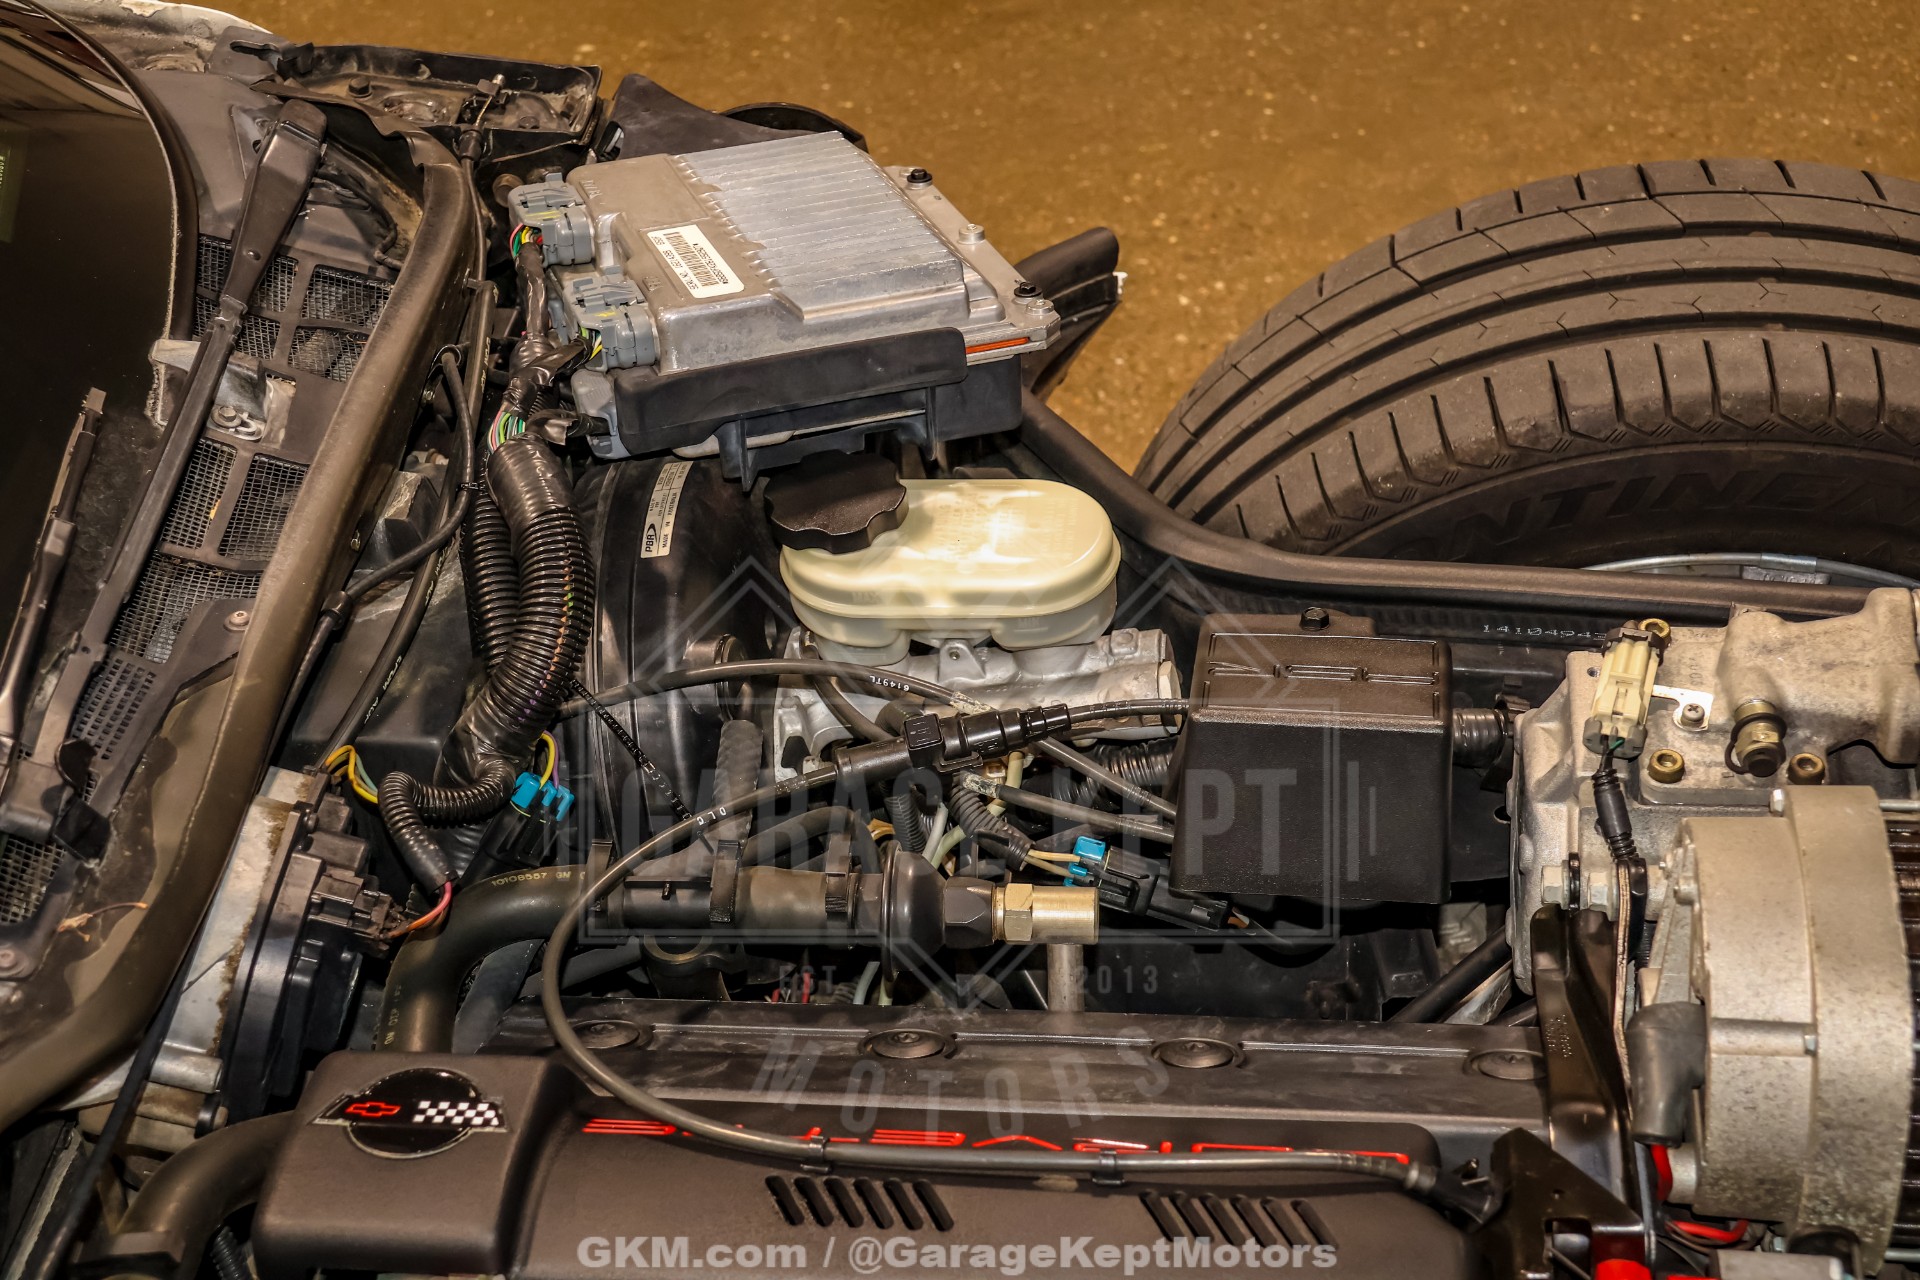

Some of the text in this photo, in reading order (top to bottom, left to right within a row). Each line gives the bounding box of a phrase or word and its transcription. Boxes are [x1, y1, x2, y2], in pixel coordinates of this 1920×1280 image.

[667, 492, 677, 515] AUSTRALIA
[645, 533, 655, 552] PBR
[868, 674, 909, 691] 6149TL
